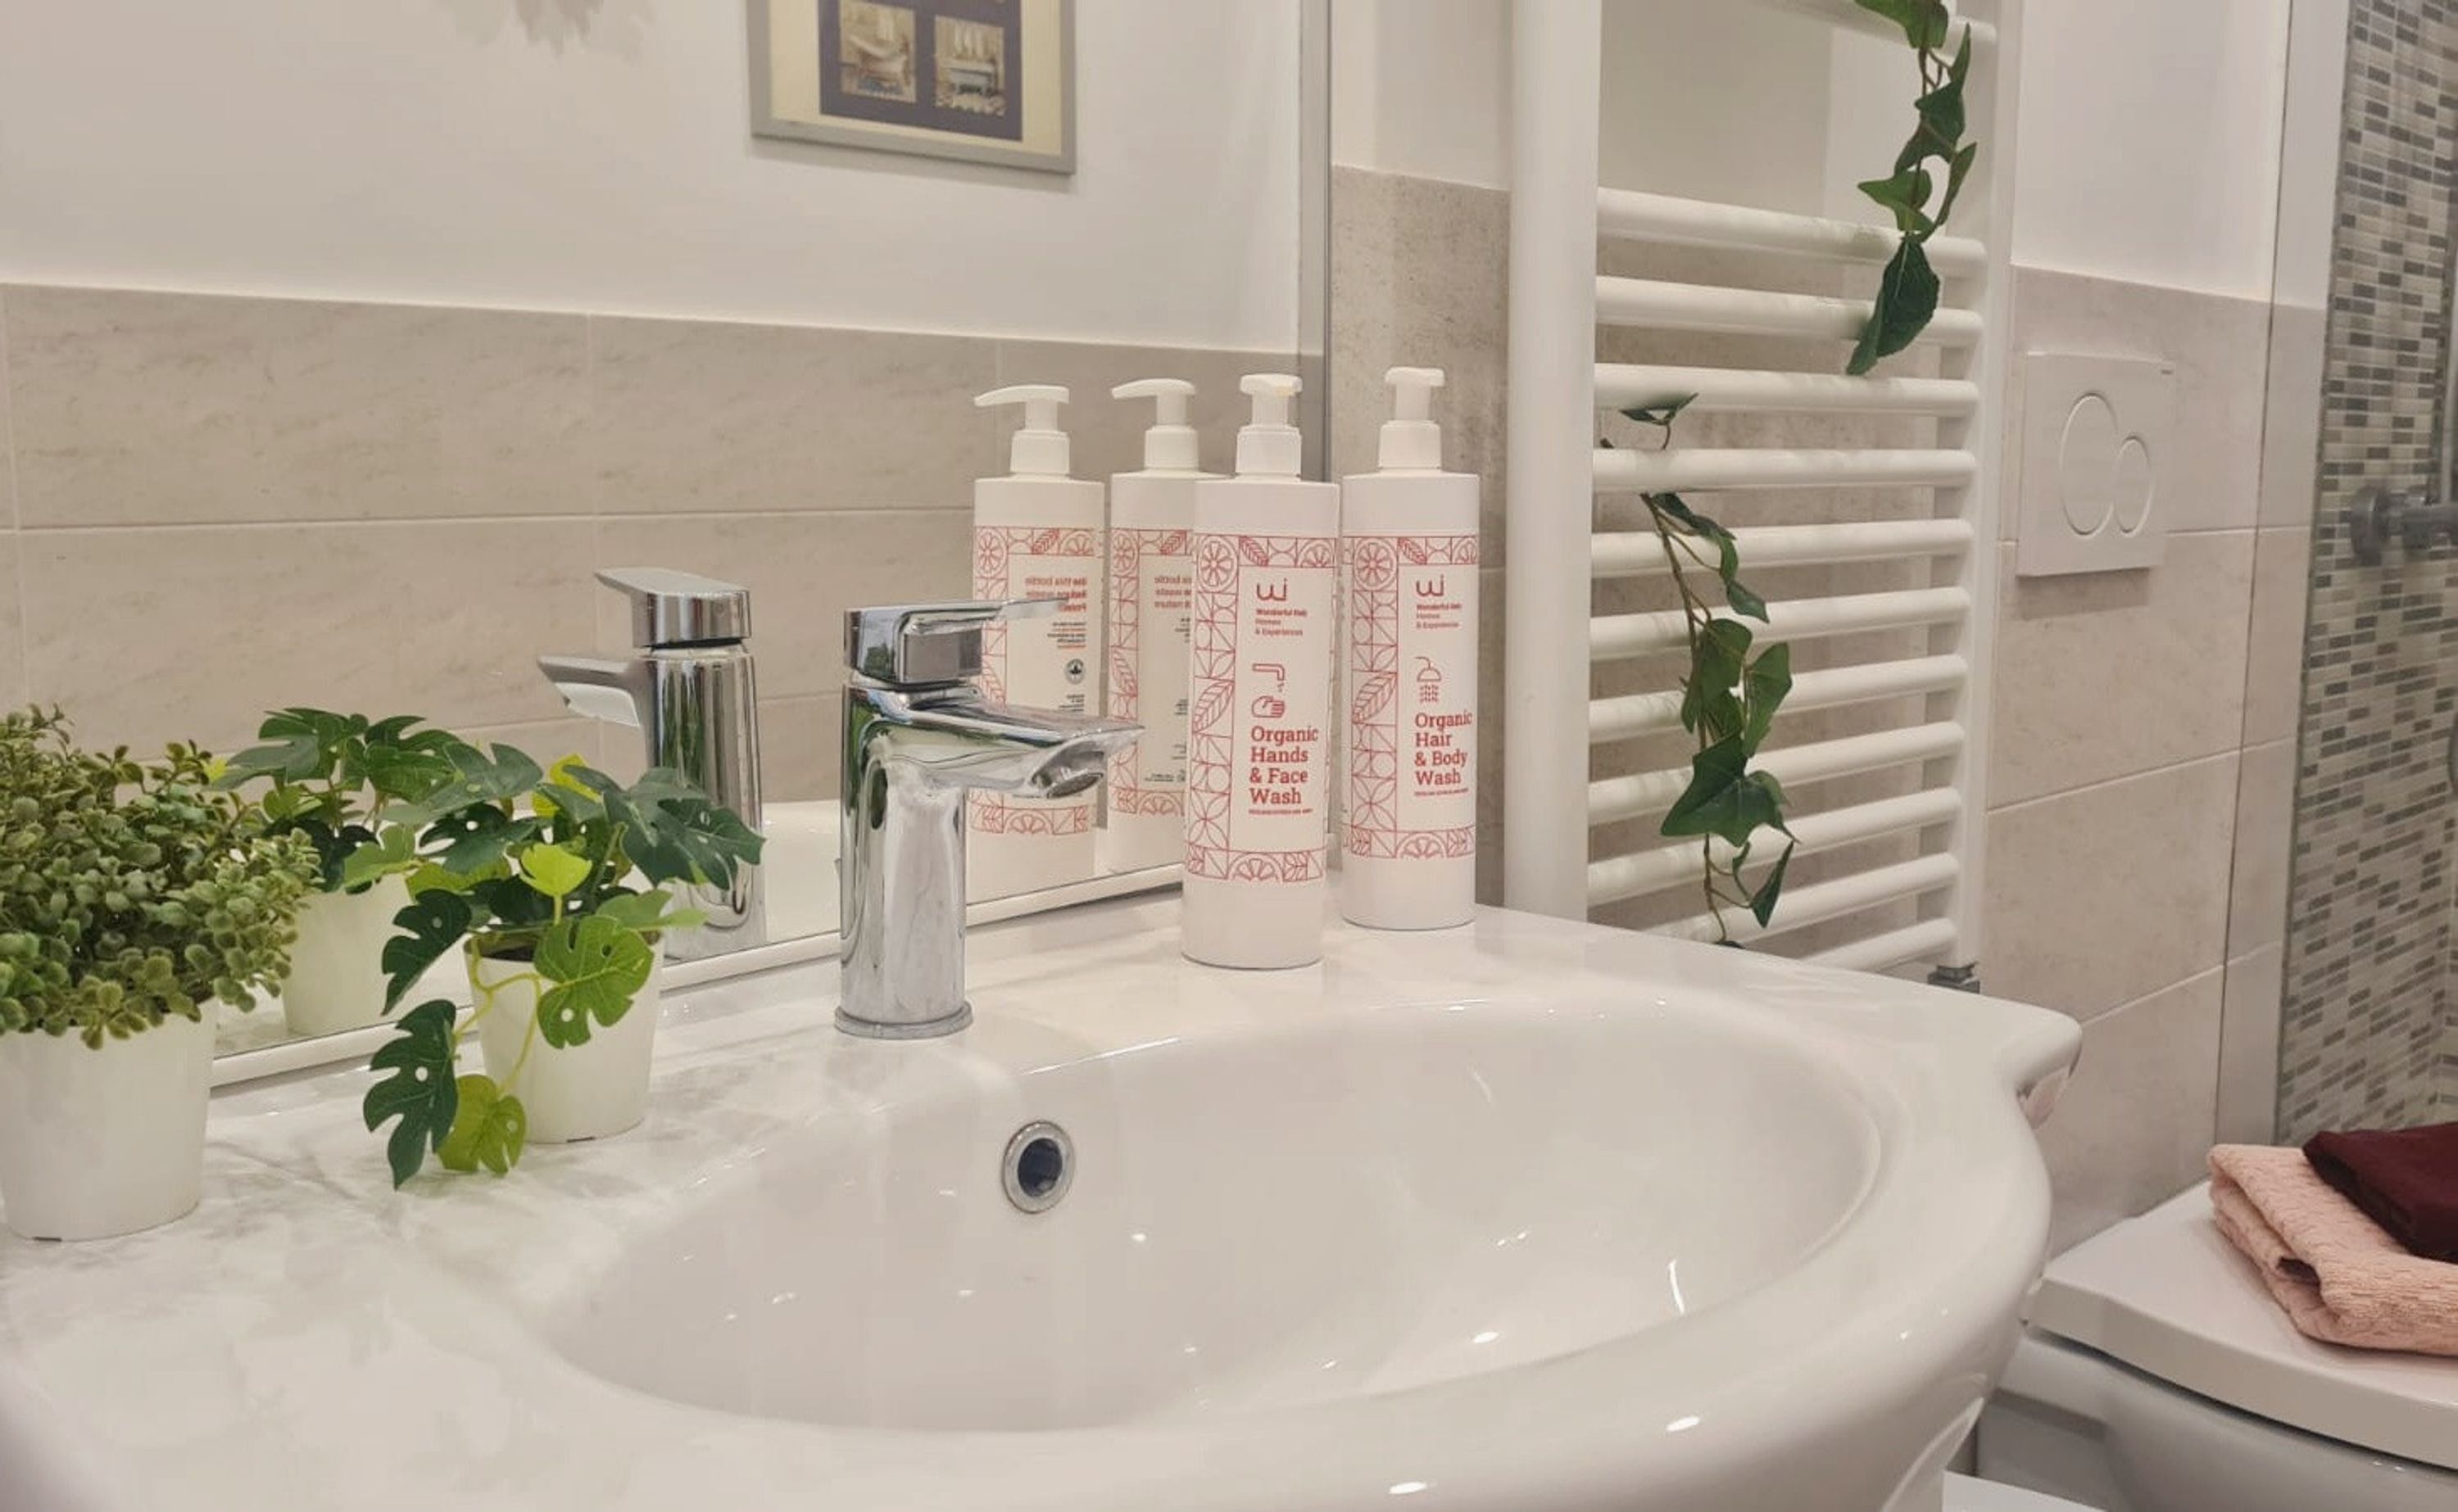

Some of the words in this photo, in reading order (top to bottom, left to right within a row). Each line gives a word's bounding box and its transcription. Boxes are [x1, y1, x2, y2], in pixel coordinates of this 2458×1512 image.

[1415, 709, 1473, 732] Organic
[1250, 725, 1319, 747] Organic
[1415, 731, 1453, 747] Hair
[1250, 746, 1308, 763] Hands
[1414, 751, 1426, 767] &
[1431, 747, 1469, 768] Body
[1249, 767, 1262, 784] &
[1267, 767, 1308, 784] Face
[1415, 767, 1462, 785] Wash
[1249, 786, 1302, 804] Wash
